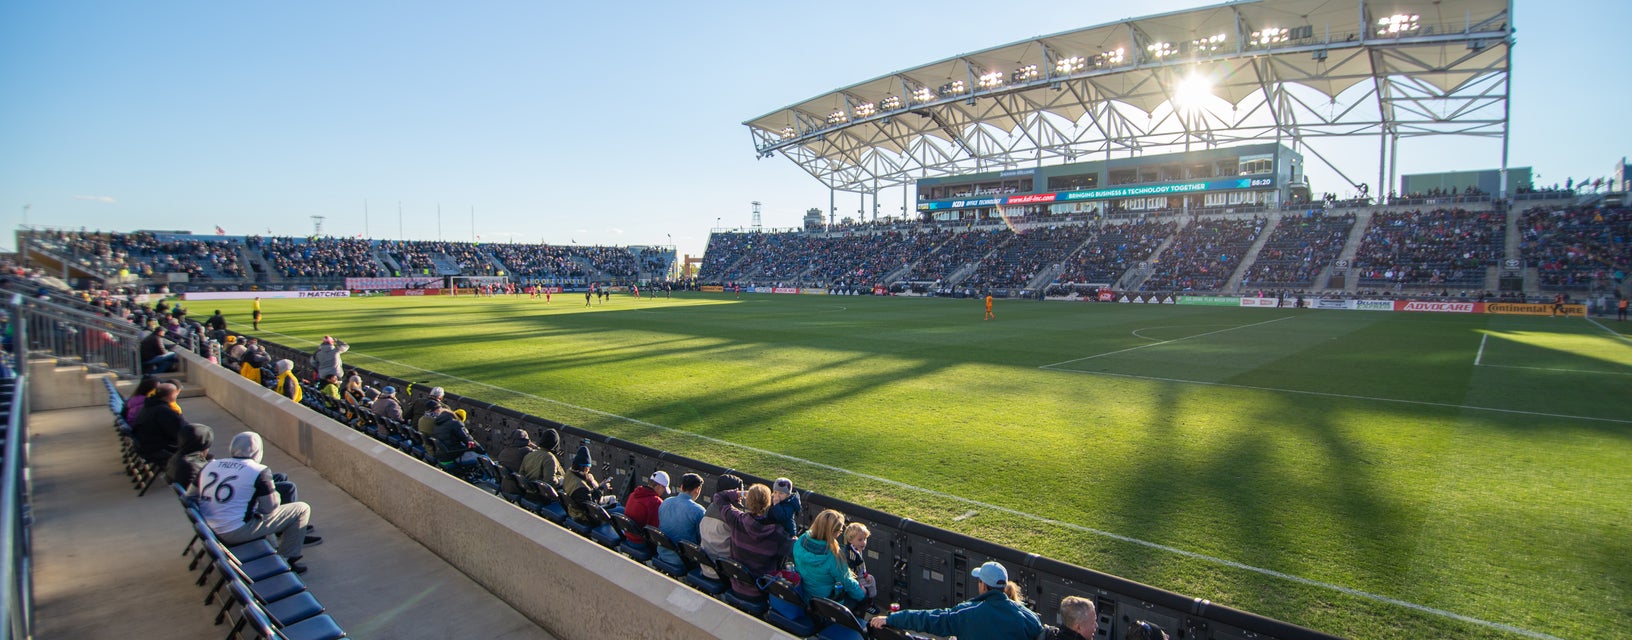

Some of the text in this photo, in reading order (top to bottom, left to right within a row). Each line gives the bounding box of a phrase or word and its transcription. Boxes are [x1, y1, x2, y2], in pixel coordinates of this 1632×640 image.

[1068, 191, 1095, 199] BRINGING
[1095, 190, 1121, 198] BUSINESS
[1128, 186, 1169, 195] TECHNOLOGY
[1171, 183, 1205, 191] TOGETHER
[1404, 302, 1473, 312] ADVOCARE
[1488, 303, 1547, 312] Continental
[218, 461, 245, 470] TRUSTY
[201, 472, 239, 503] 26
